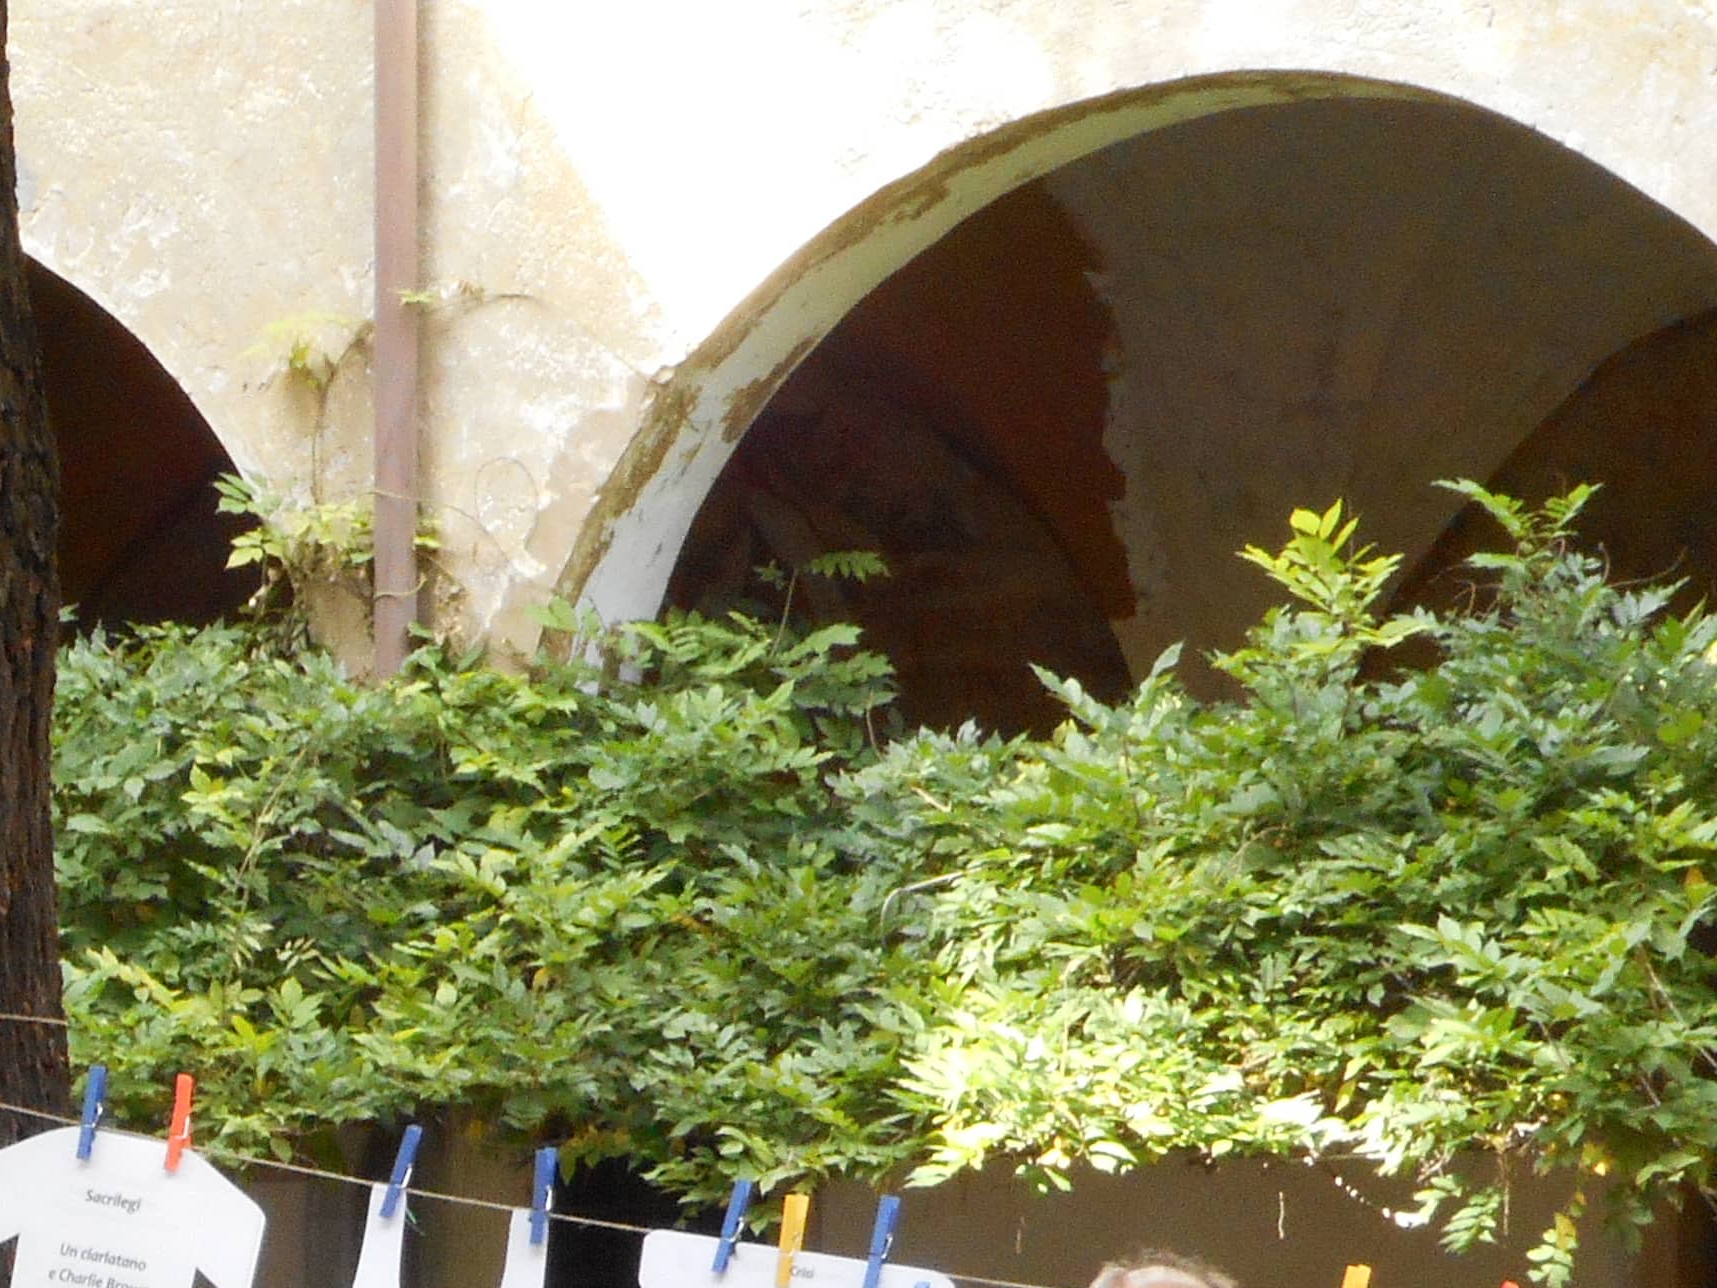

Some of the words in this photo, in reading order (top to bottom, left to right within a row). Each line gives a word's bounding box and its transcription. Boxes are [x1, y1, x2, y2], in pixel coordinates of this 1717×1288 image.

[85, 1189, 142, 1215] Sacrilegi
[60, 1242, 78, 1258] Un
[80, 1248, 147, 1272] ciarlatano
[48, 1269, 57, 1280] e
[59, 1268, 103, 1288] Charlie
